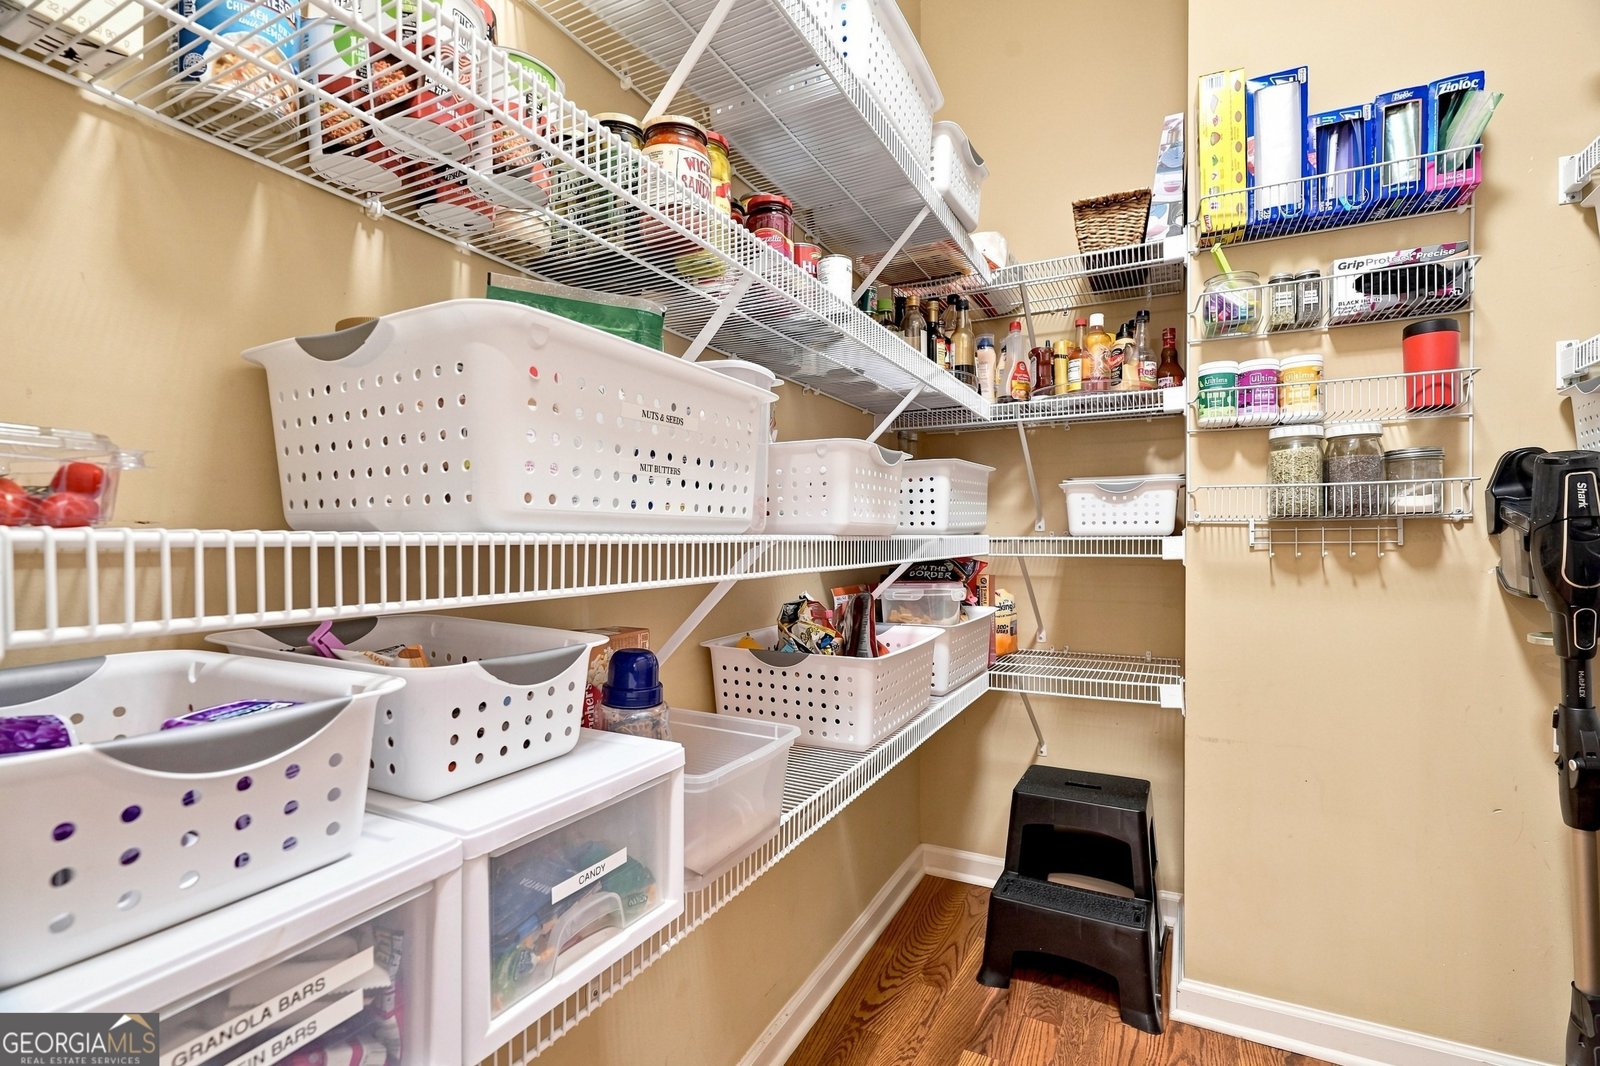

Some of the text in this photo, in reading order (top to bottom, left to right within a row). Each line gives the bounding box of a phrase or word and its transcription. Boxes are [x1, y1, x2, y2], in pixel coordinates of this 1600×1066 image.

[1438, 78, 1480, 95] Ziploc
[1416, 248, 1456, 259] Precise
[1338, 299, 1359, 307] BLACK
[1251, 373, 1278, 382] Ultima
[642, 410, 660, 421] NUTS
[666, 415, 684, 426] SEEDS
[640, 463, 681, 476] NUT BUTTERS
[1577, 482, 1588, 508] Shark
[909, 570, 952, 580] BORDER
[578, 863, 606, 885] CANDY
[171, 1007, 272, 1066] GRANOLA
[278, 977, 326, 1013] BARS
[271, 1020, 318, 1058] BARS
